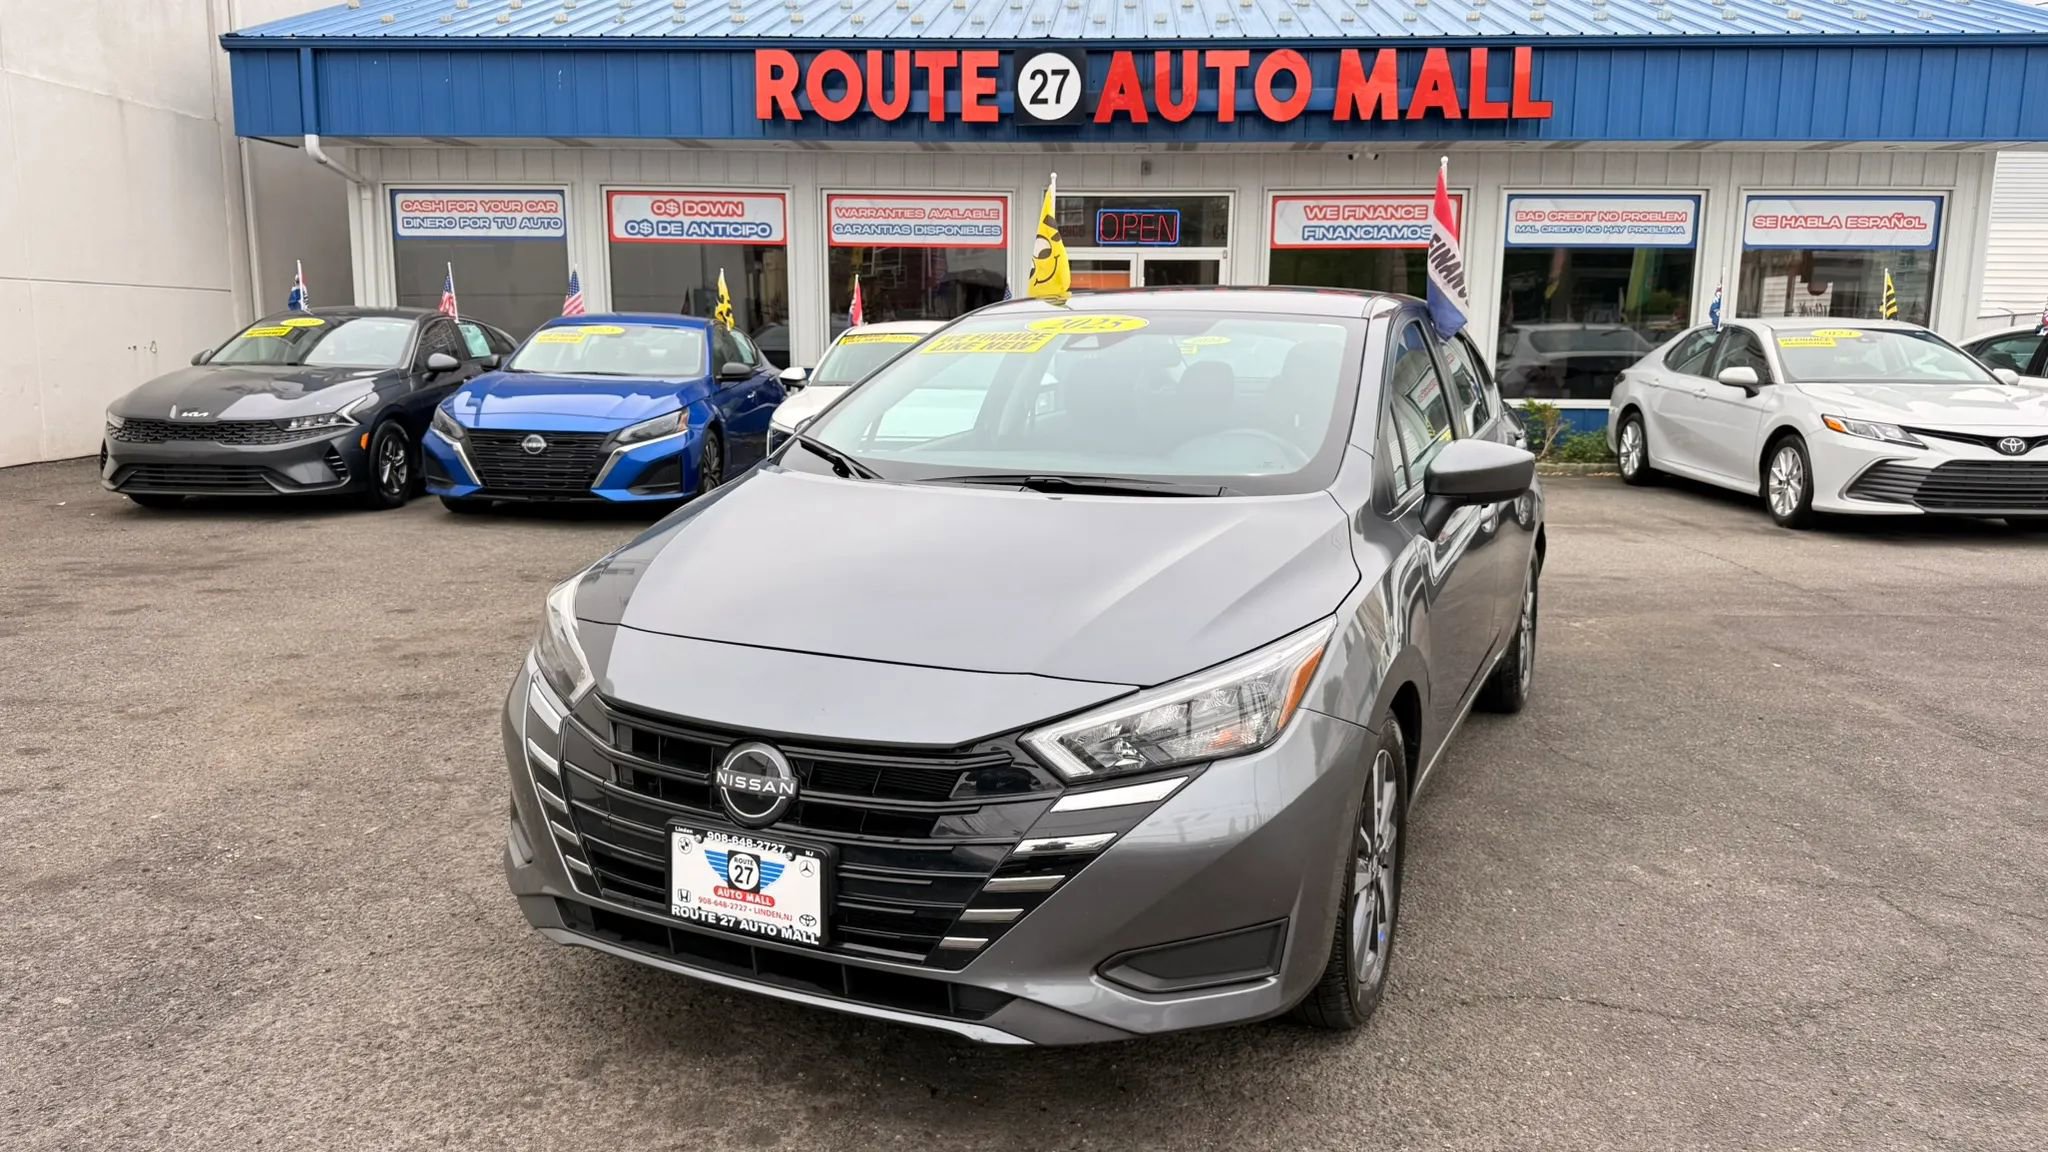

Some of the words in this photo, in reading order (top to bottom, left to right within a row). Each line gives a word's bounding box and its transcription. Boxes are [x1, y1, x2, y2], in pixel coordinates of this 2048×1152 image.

[755, 49, 1000, 122] ROUTE
[1029, 68, 1070, 105] 27
[1094, 49, 1312, 123] AUTO
[1332, 46, 1553, 121] MALL
[401, 200, 444, 213] CASH
[447, 200, 477, 213] FOR
[480, 200, 523, 213] YOUR
[525, 200, 558, 214] CAR
[683, 201, 744, 217] DOWN
[835, 207, 924, 219] WARRANTIES
[928, 208, 1000, 220] AVAILABLE
[1304, 205, 1341, 221] WE
[1342, 205, 1428, 220] FINANCE
[402, 216, 456, 229] DINERO
[459, 216, 491, 229] POR
[493, 216, 516, 229] TU
[519, 217, 562, 230] AUTO
[1516, 211, 1545, 222] BAD
[1548, 211, 1597, 222] CREDIT
[1599, 211, 1619, 222] NO
[1621, 211, 1687, 223] PROBLEM
[1753, 215, 1778, 229] SE
[1780, 215, 1842, 229] HABLA
[1845, 212, 1926, 230] ESPAÑOL
[656, 220, 684, 236] DE
[686, 221, 772, 238] ANTICIPO
[833, 223, 911, 236] GARANTIAS
[913, 224, 1002, 237] DISPONIBLES
[1099, 212, 1177, 242] OPEN
[1302, 225, 1432, 241] FINANCIAMOS
[1515, 225, 1539, 234] MAL
[1540, 225, 1584, 234] CREDITO
[1586, 225, 1601, 234] NO
[1603, 225, 1627, 235] HAY
[1627, 225, 1685, 235] PROBLEMA
[1043, 318, 1135, 330] 2025
[930, 341, 978, 351] LIKE
[979, 341, 1037, 351] NEW
[716, 771, 794, 795] NISSAN
[675, 826, 693, 834] Linden
[707, 831, 786, 854] 908-648-2727
[734, 856, 754, 866] ROUTE
[734, 865, 754, 885] 27
[717, 887, 742, 900] AUTO
[745, 891, 773, 906] MALL
[671, 904, 717, 924] ROUTE
[719, 915, 738, 928] 27
[739, 919, 777, 937] AUTO
[781, 927, 820, 945] MALL
